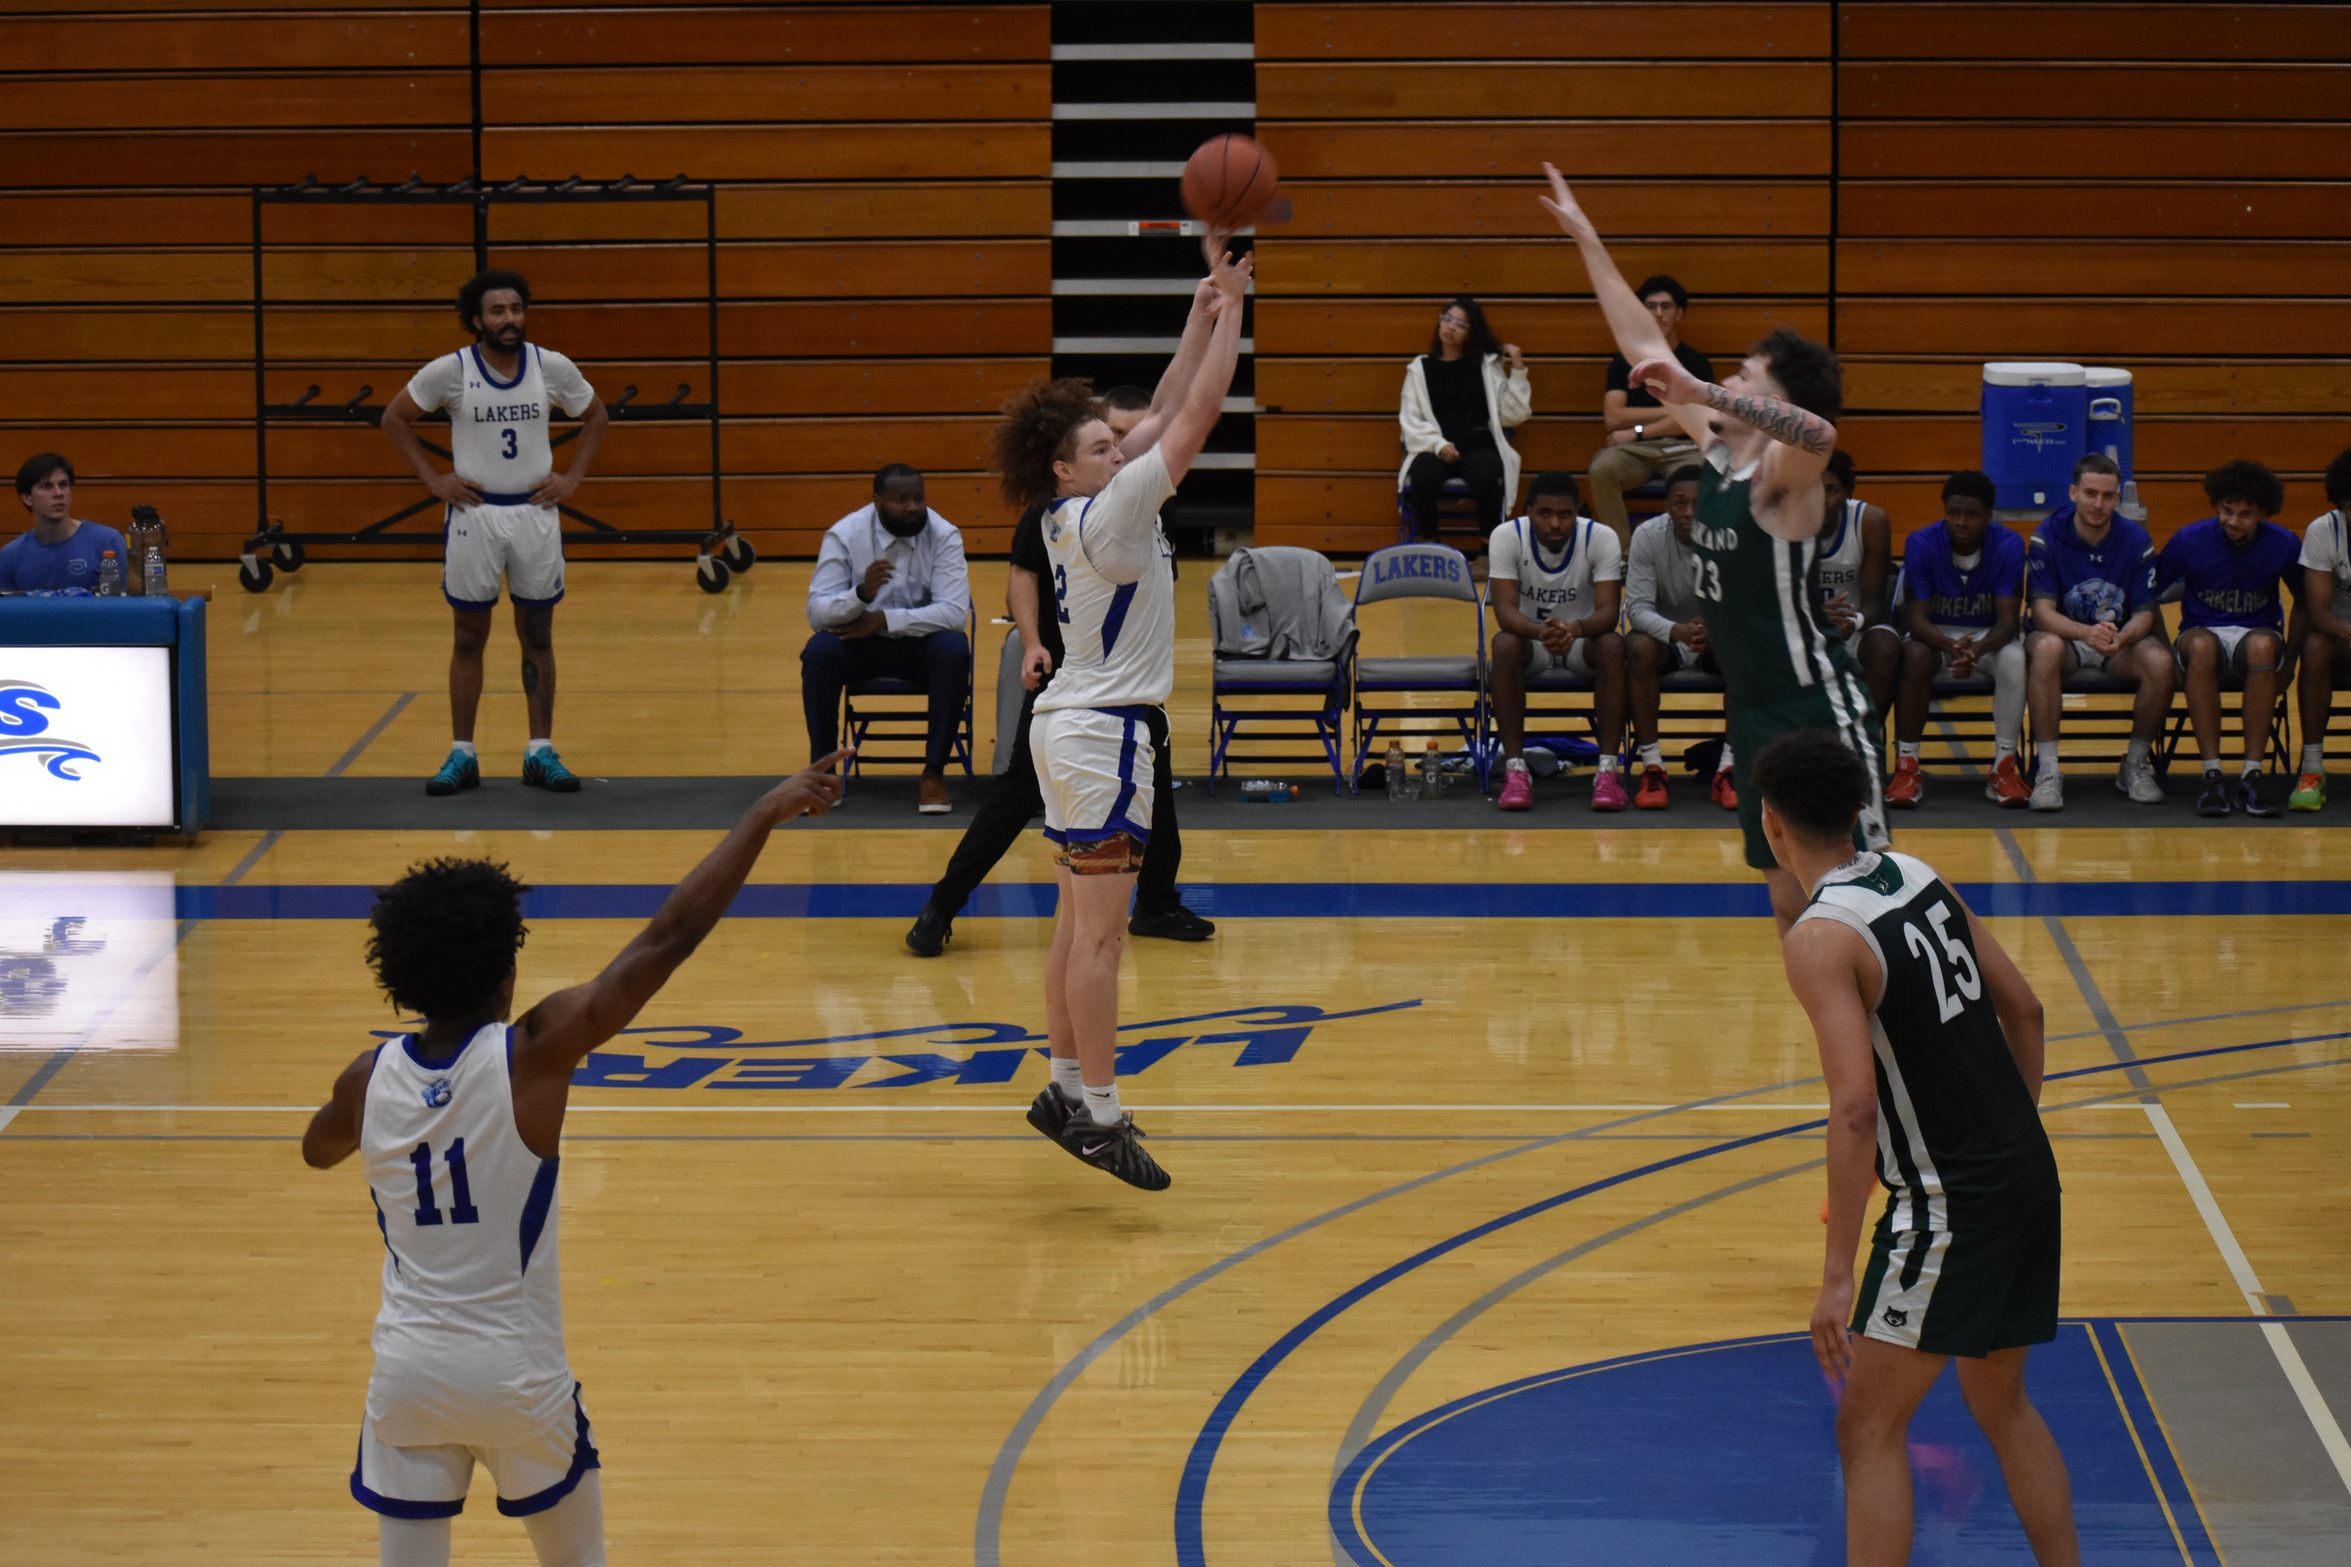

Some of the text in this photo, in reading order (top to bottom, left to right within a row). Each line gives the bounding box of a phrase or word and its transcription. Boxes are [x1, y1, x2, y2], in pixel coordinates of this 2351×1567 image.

[474, 403, 540, 422] LAKERS
[501, 428, 518, 459] 3
[1374, 554, 1460, 584] LAKERS
[1691, 553, 1722, 603] 23
[1822, 570, 1855, 584] ERS
[1931, 592, 1992, 618] AKELAN
[1903, 900, 1982, 1024] 25
[569, 1026, 1314, 1090] LAKER
[410, 1137, 479, 1227] 11
